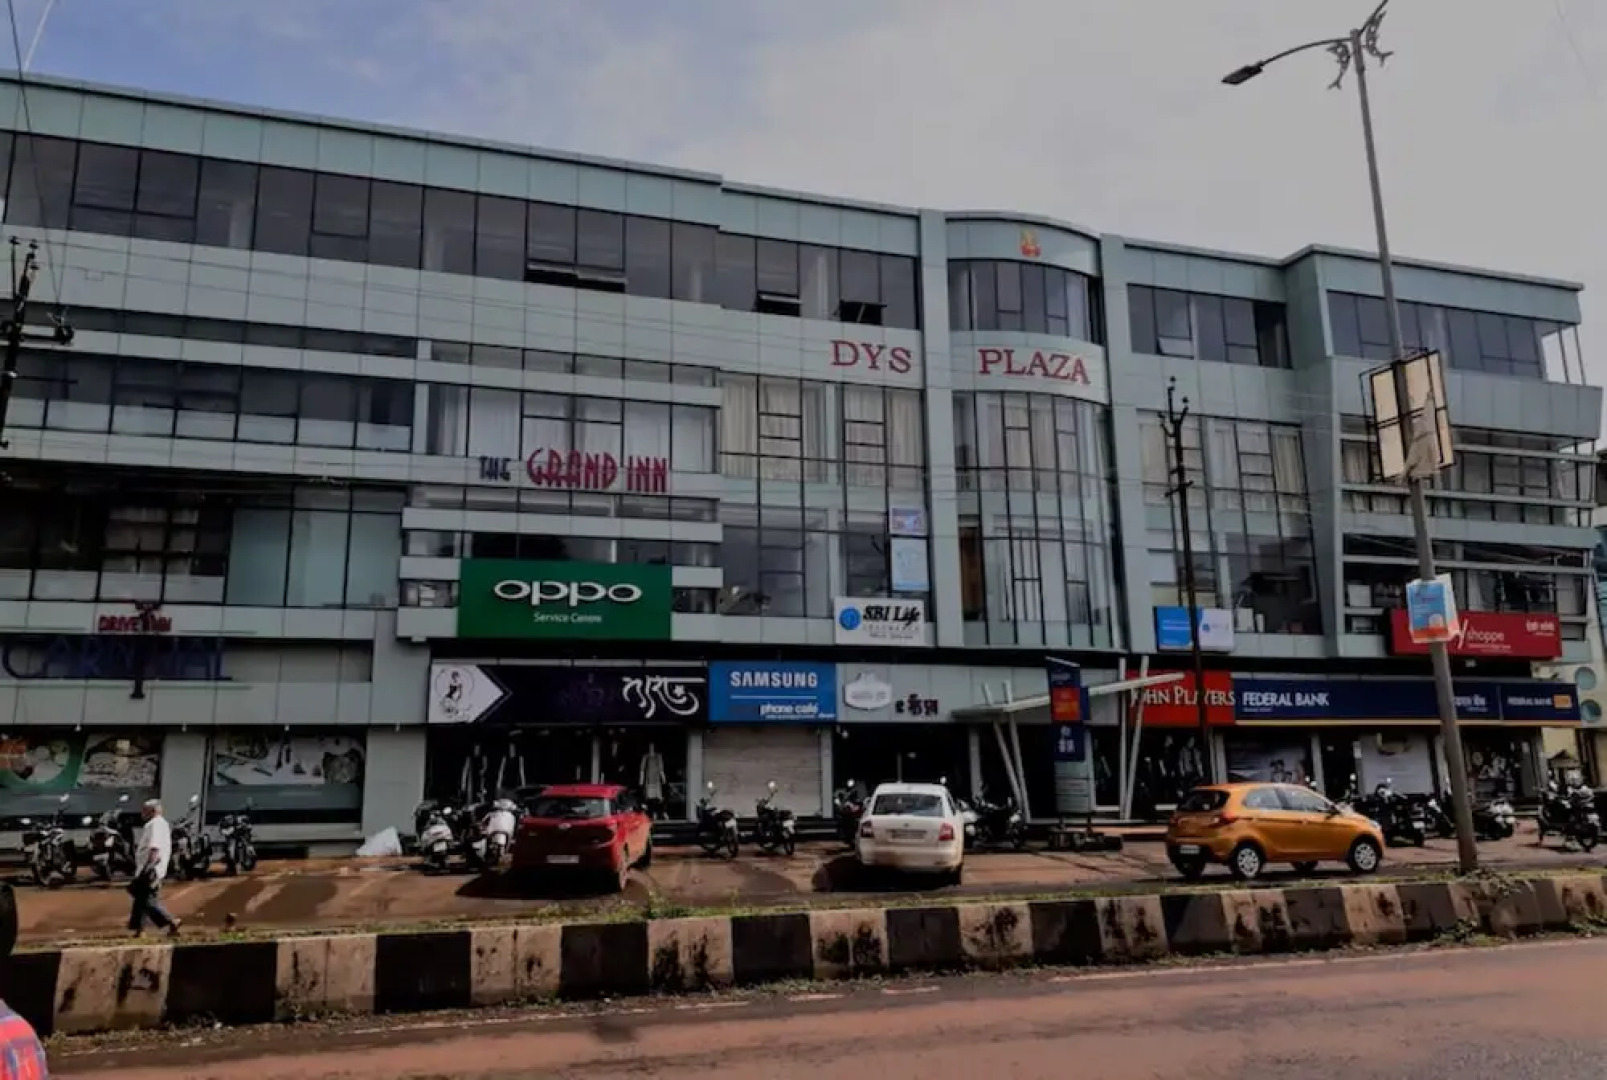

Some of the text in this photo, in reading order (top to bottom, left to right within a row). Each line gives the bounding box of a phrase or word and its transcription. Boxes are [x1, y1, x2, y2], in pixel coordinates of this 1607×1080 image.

[829, 340, 1091, 384] DYS PLAZA
[479, 447, 667, 493] THE GRAND INN
[533, 612, 569, 623] Service
[863, 605, 920, 626] SBI Life
[730, 671, 818, 687] SAMSUNG
[1242, 692, 1330, 706] FEDERAL BANK
